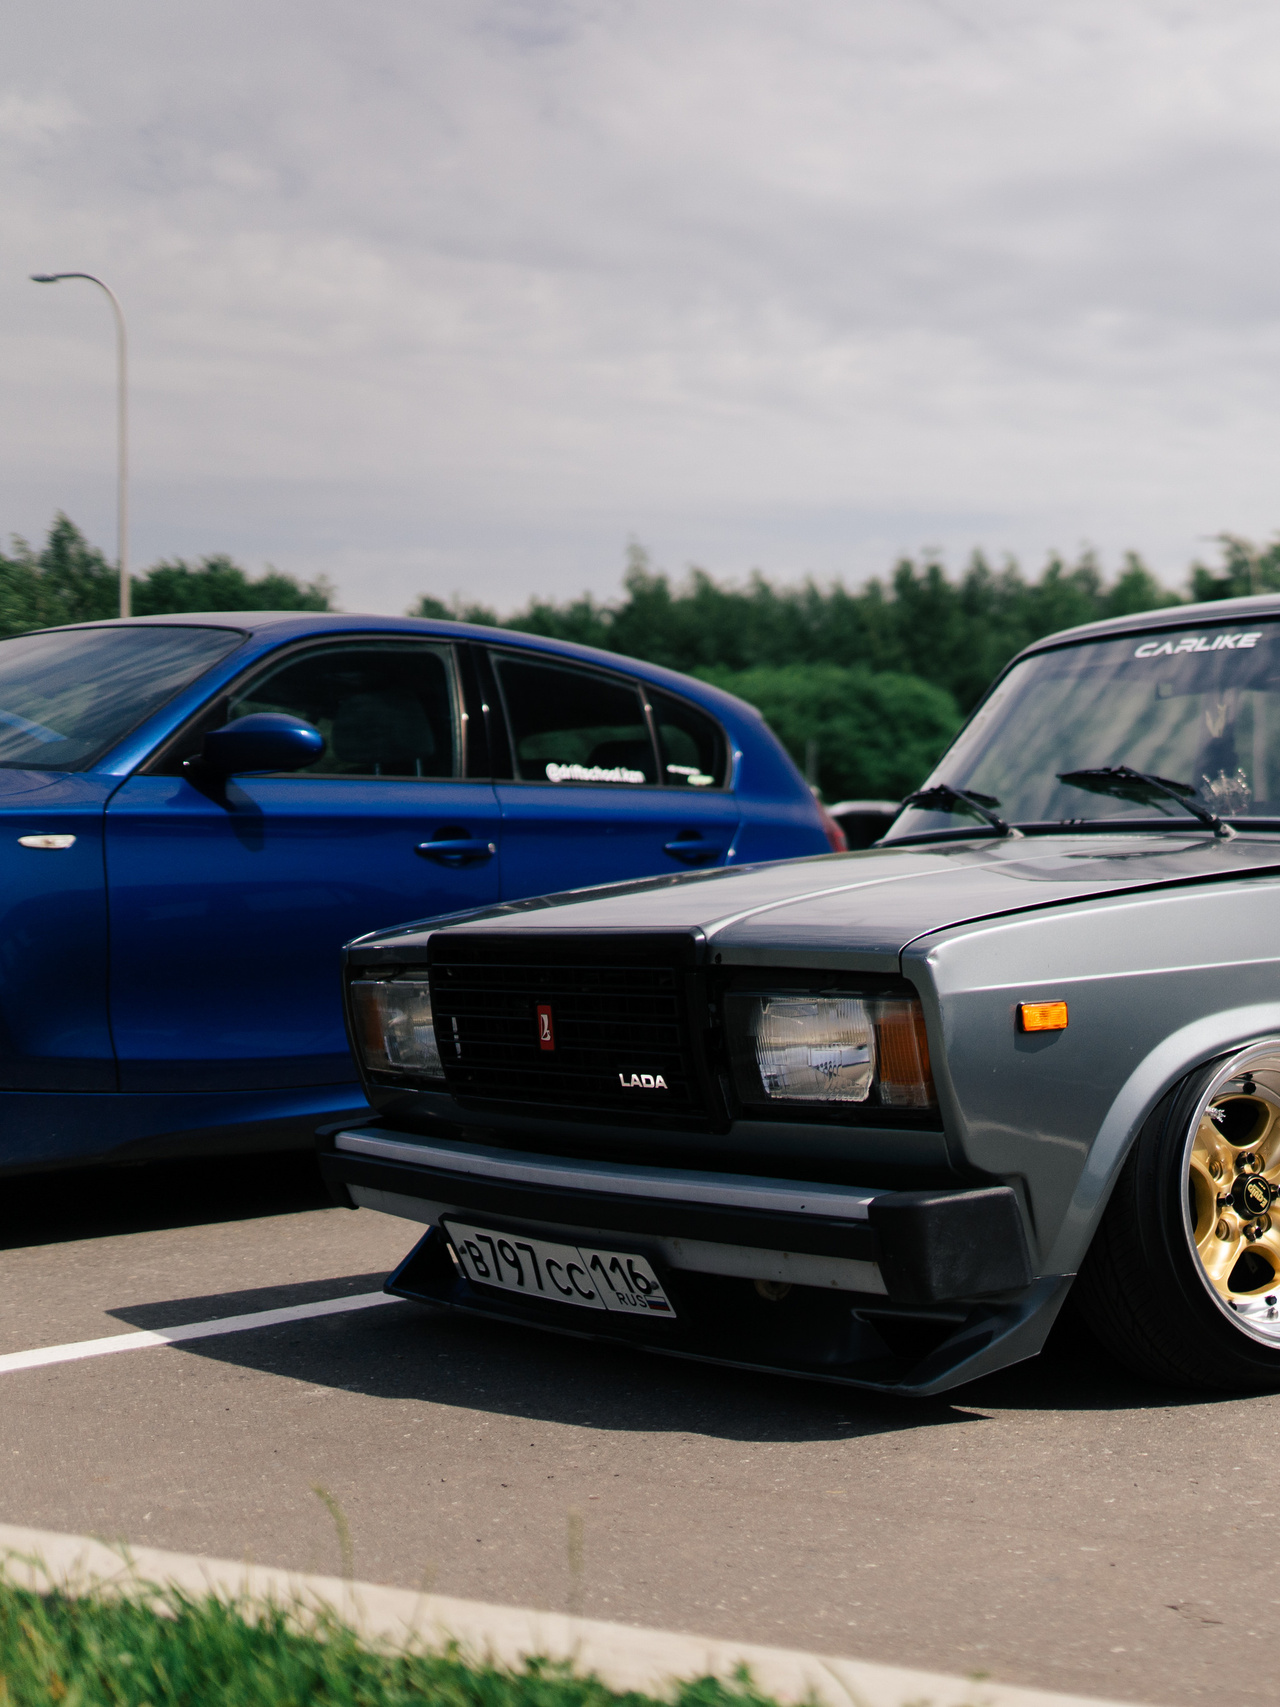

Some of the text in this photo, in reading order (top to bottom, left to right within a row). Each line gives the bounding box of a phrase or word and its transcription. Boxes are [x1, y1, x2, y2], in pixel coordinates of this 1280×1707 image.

[1134, 632, 1263, 658] CARLIKE
[619, 1073, 668, 1089] LADA
[617, 1292, 648, 1309] RUS
